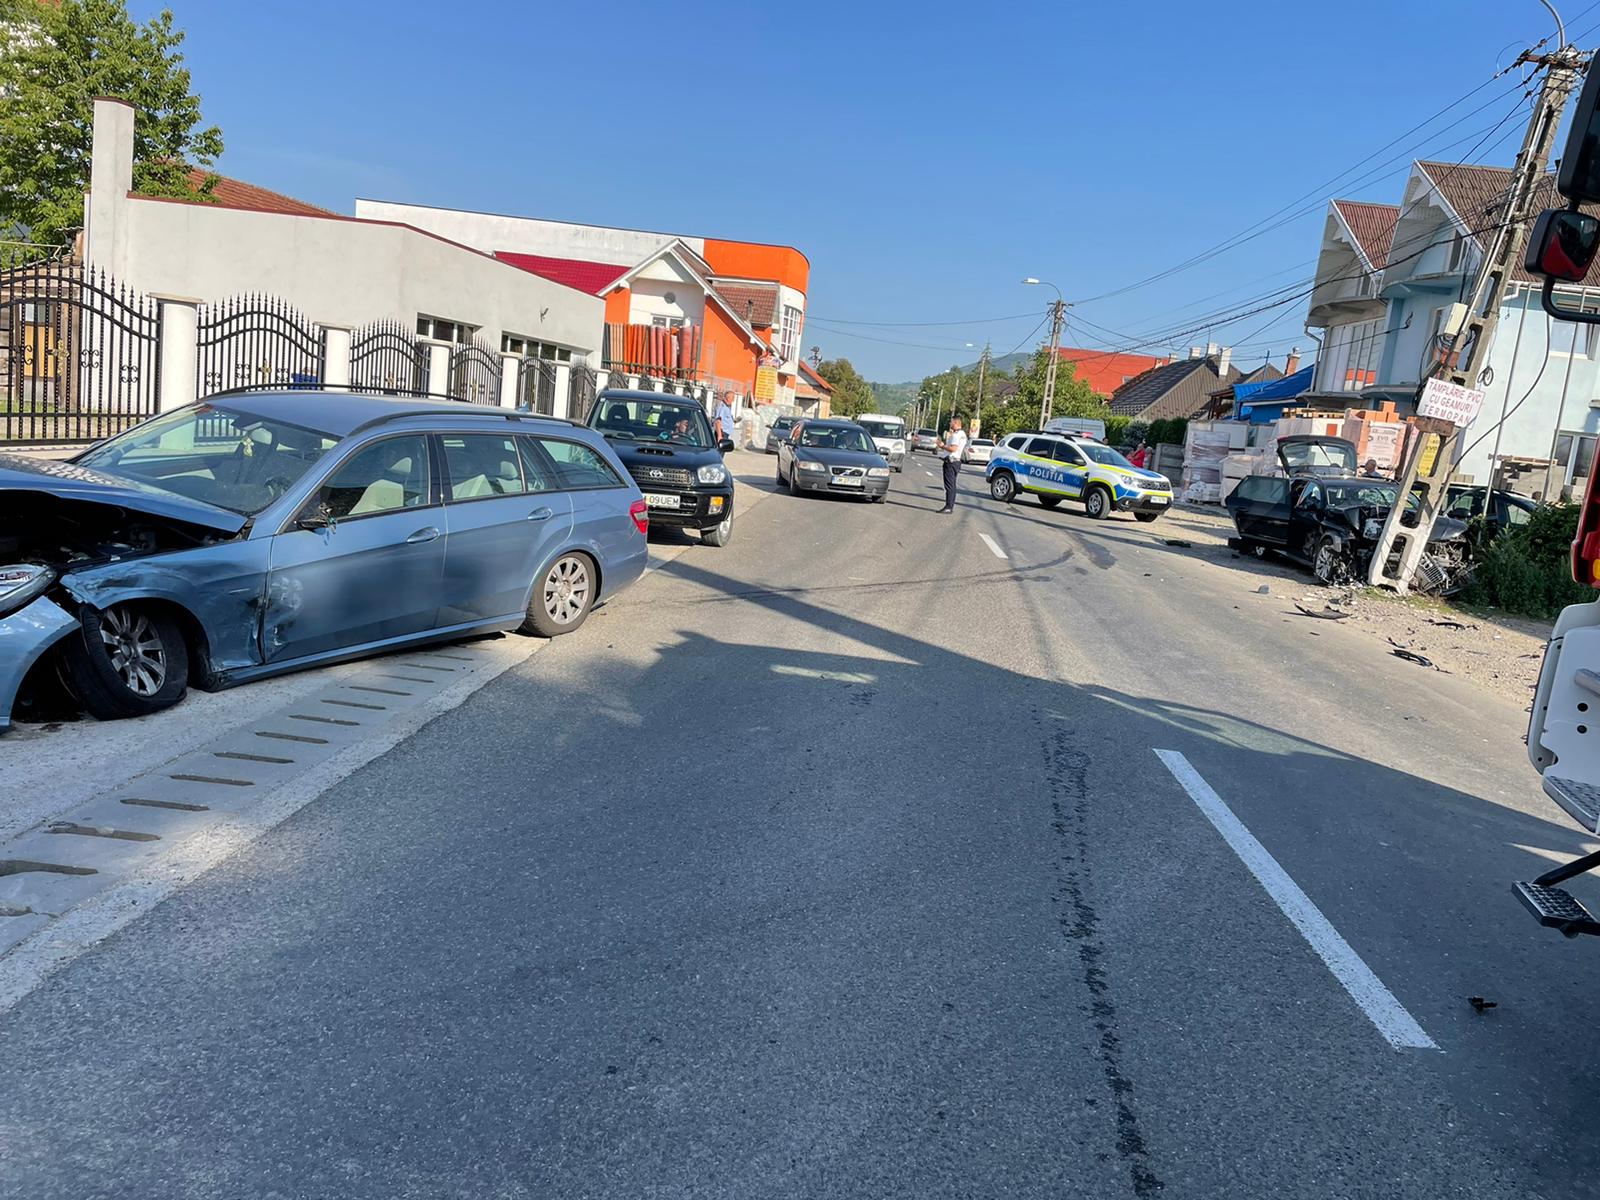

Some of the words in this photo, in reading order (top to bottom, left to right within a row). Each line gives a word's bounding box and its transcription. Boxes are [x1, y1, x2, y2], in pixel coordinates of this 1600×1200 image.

[1429, 393, 1441, 404] CU
[1440, 397, 1474, 413] GEAMURI
[1466, 391, 1482, 404] PVC
[1422, 404, 1472, 425] TERMOPAN
